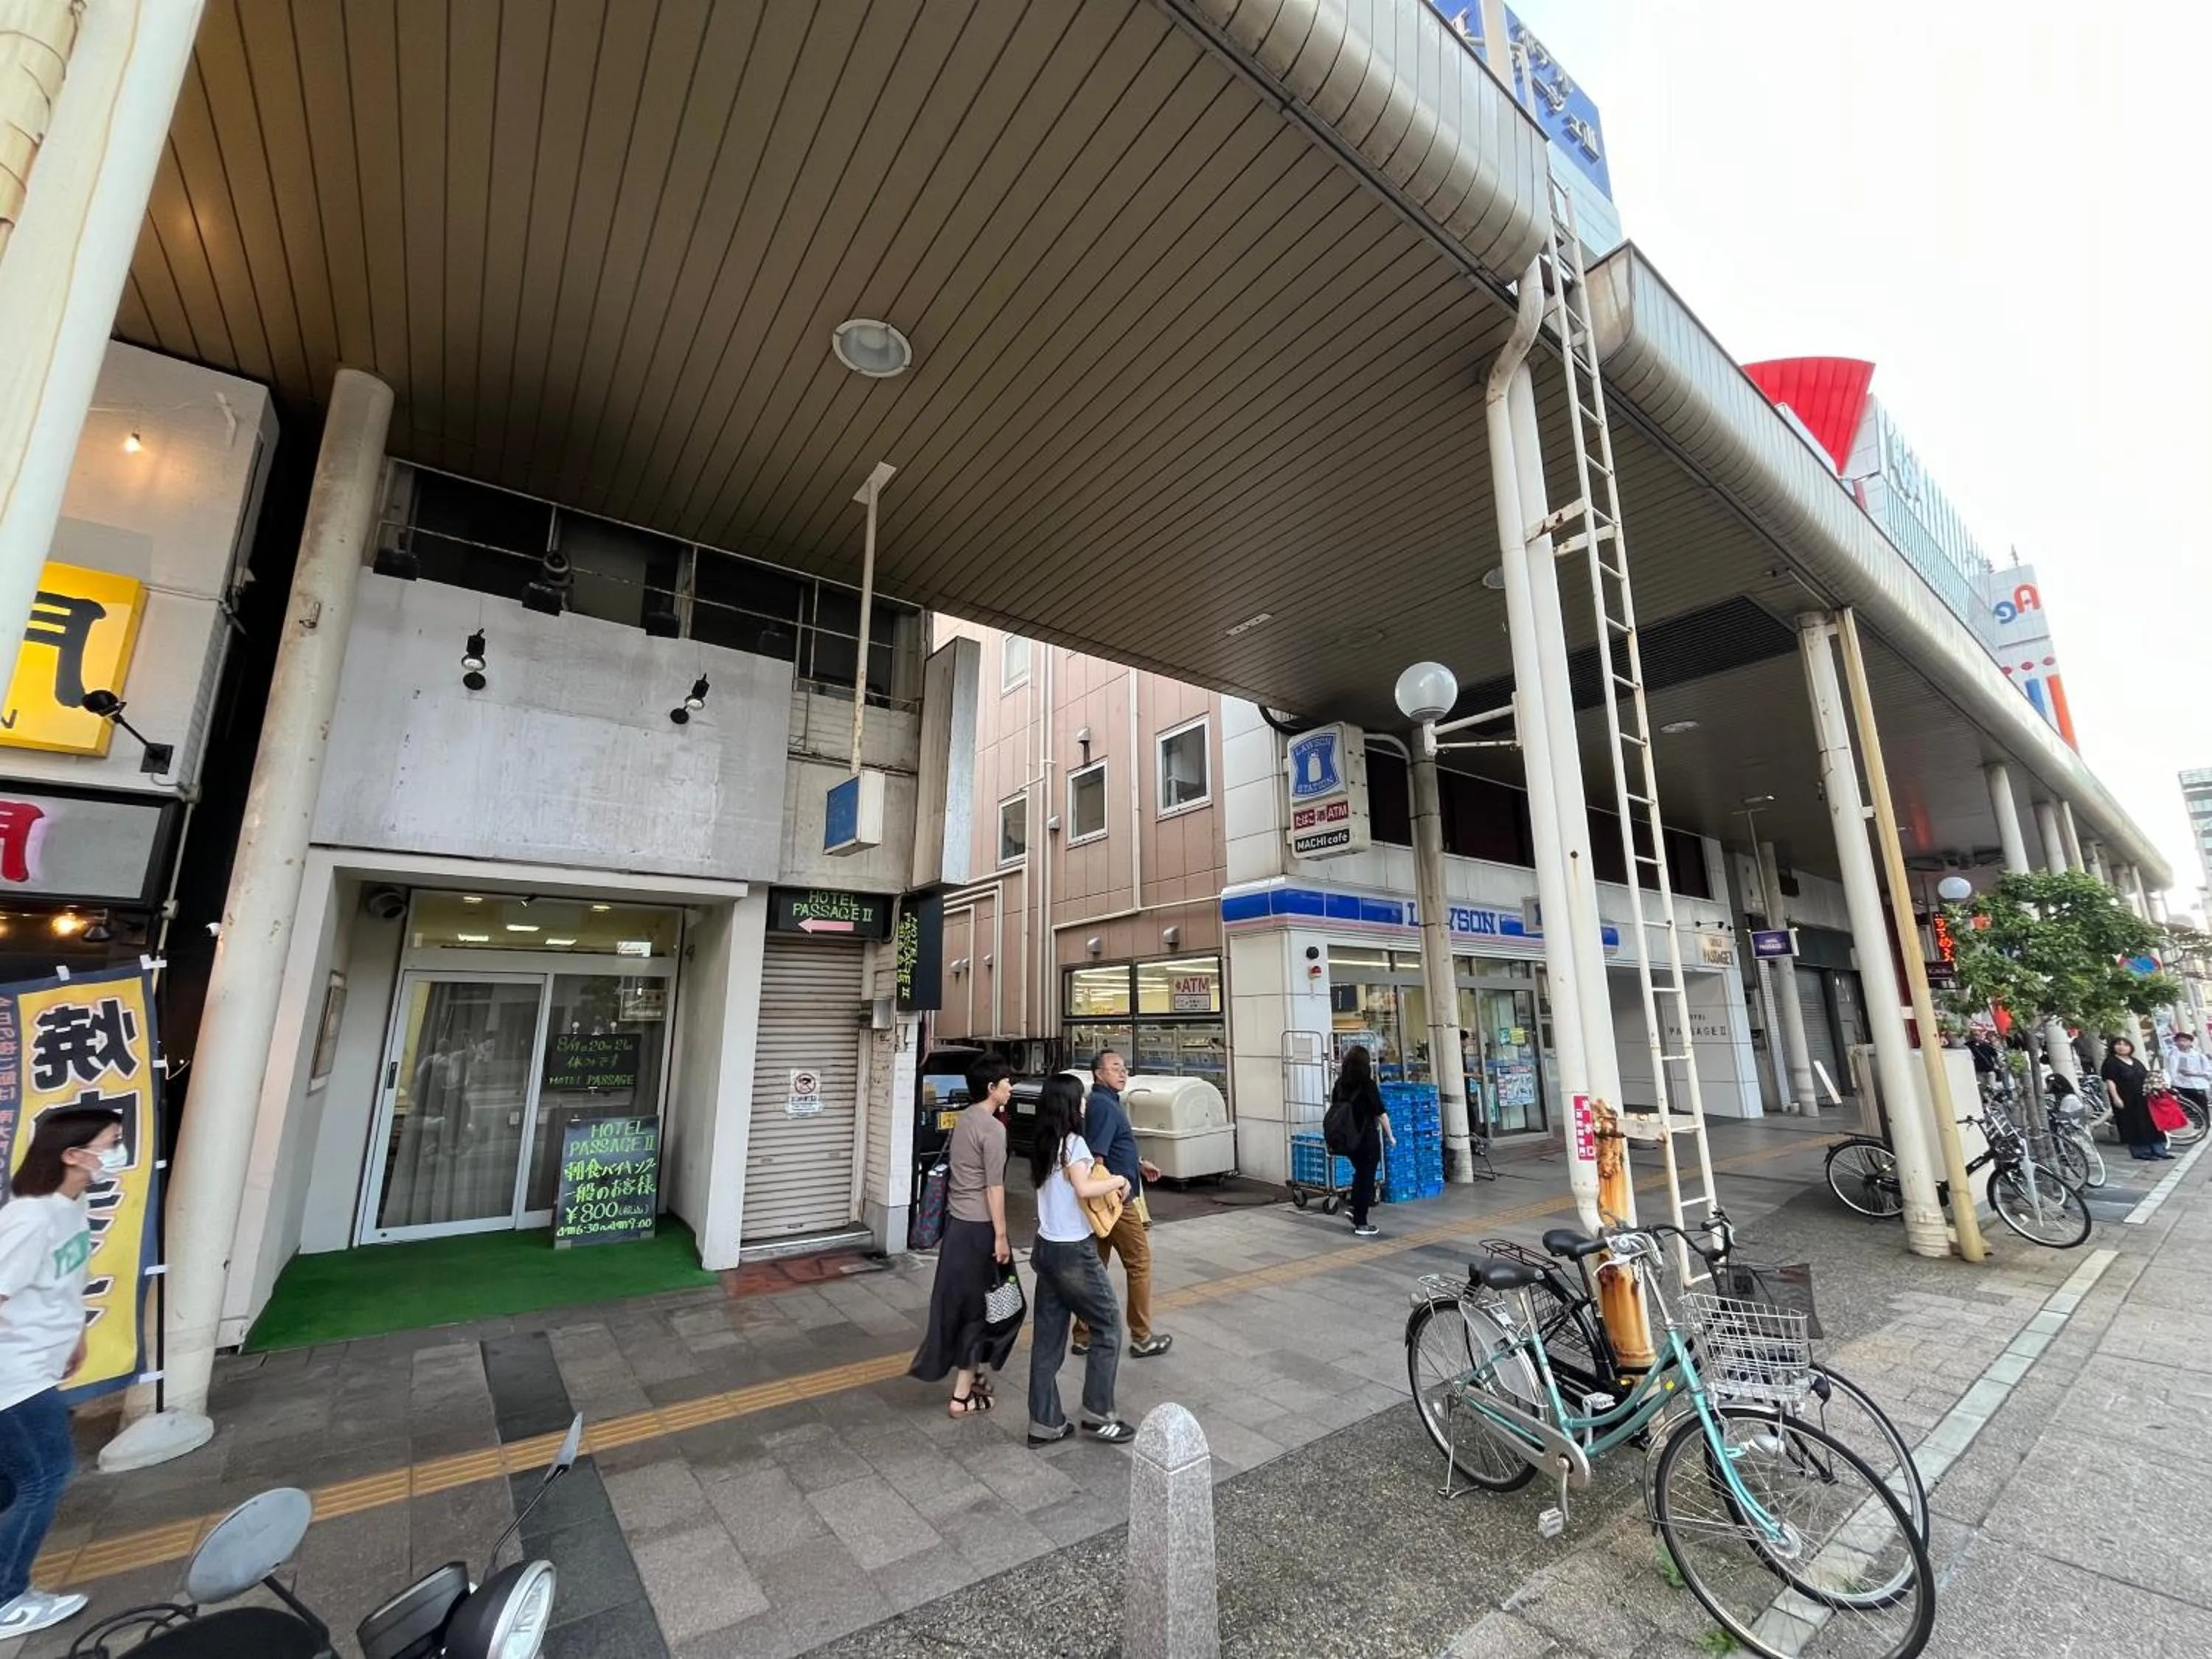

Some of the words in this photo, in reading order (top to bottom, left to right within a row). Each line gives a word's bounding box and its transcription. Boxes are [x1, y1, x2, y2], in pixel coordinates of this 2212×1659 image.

[1295, 737, 1331, 755] LAWSON
[1297, 775, 1335, 793] STATION
[1328, 804, 1347, 819] ATM
[1297, 836, 1326, 851] MACHI
[809, 890, 859, 907] HOTEL
[792, 902, 859, 921] PASSAGE
[1406, 902, 1497, 934] LSON
[1181, 977, 1210, 992] ATM
[591, 1120, 646, 1138] HOTEL
[568, 1136, 640, 1158] PASSAGE
